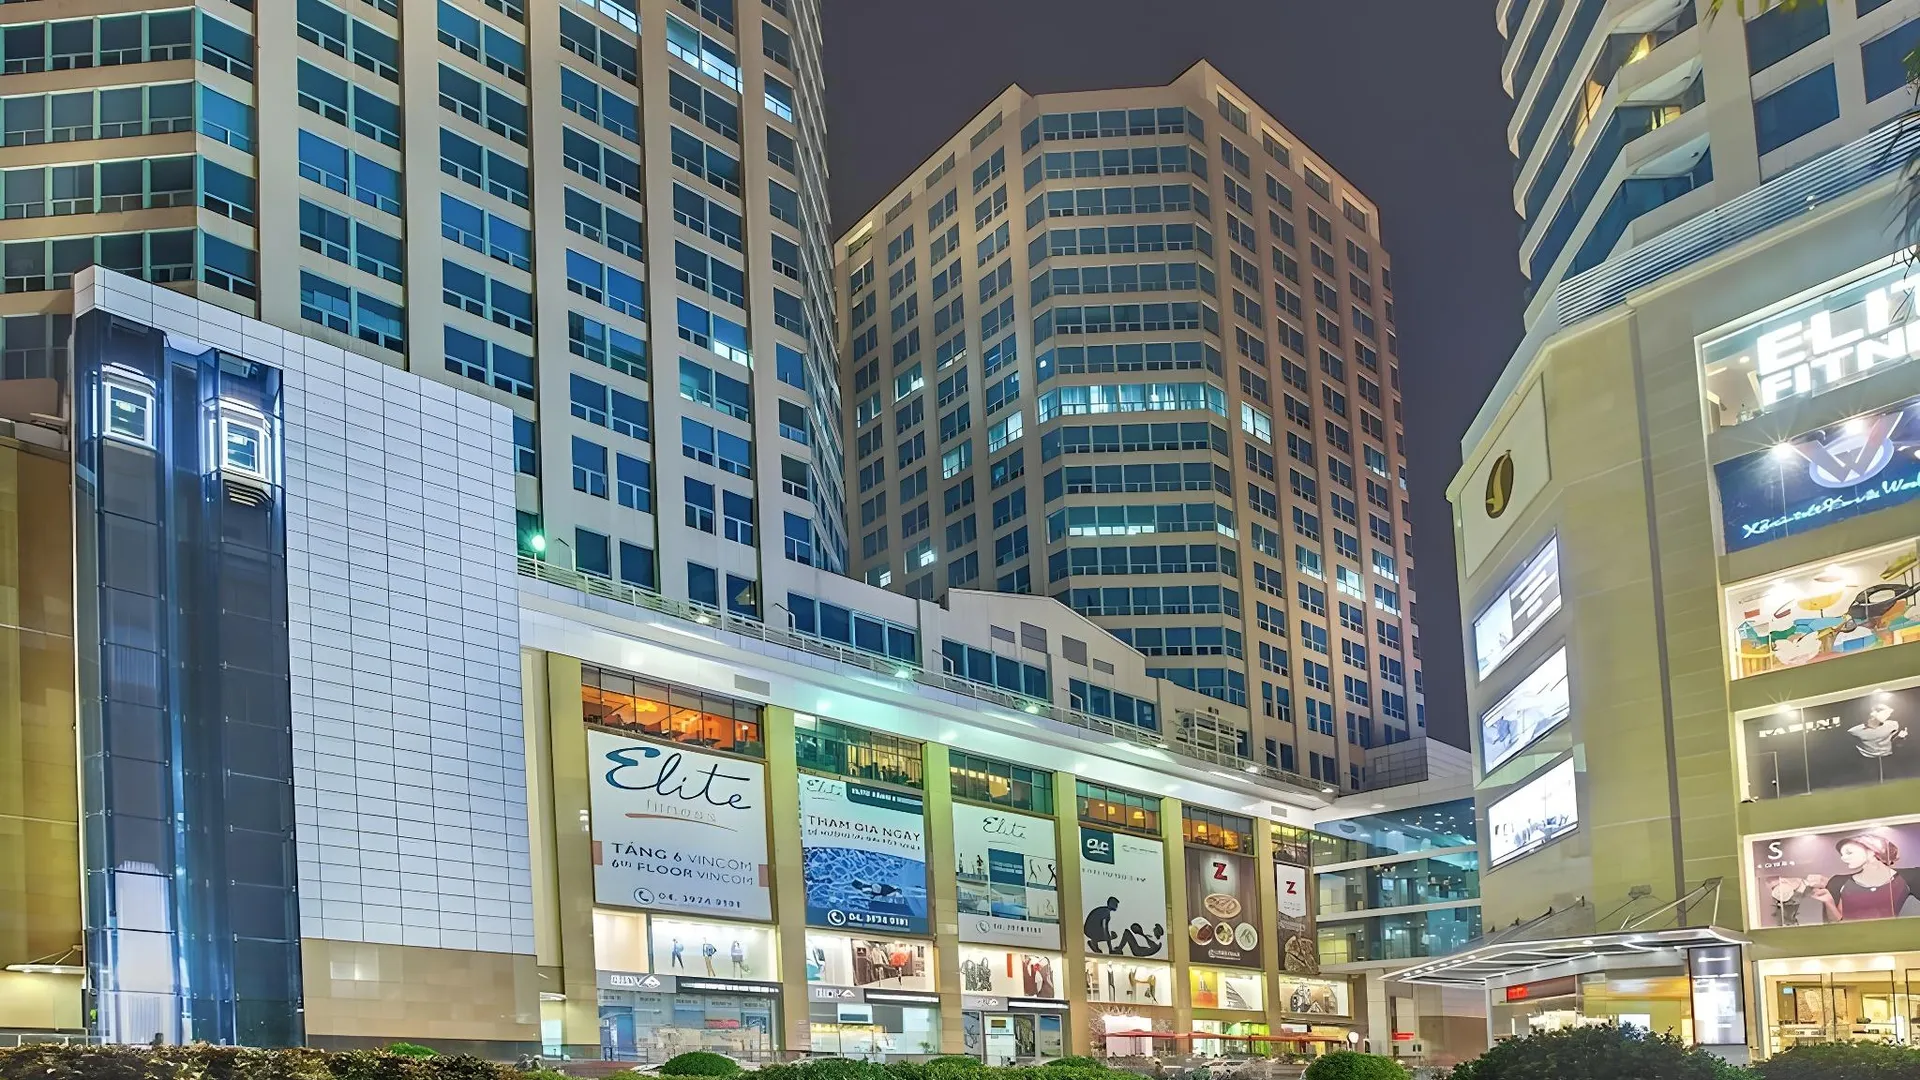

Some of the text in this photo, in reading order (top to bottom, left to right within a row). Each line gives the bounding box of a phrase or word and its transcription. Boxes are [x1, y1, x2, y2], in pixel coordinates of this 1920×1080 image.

[605, 746, 751, 810] Elite
[808, 815, 850, 830] THAM
[883, 827, 921, 842] NGAY
[673, 851, 682, 862] 6
[688, 853, 752, 872] VINCOM
[1213, 862, 1228, 881] Z
[637, 861, 693, 878] FLOOR
[697, 870, 753, 886] VINCOM
[1286, 881, 1297, 895] Z
